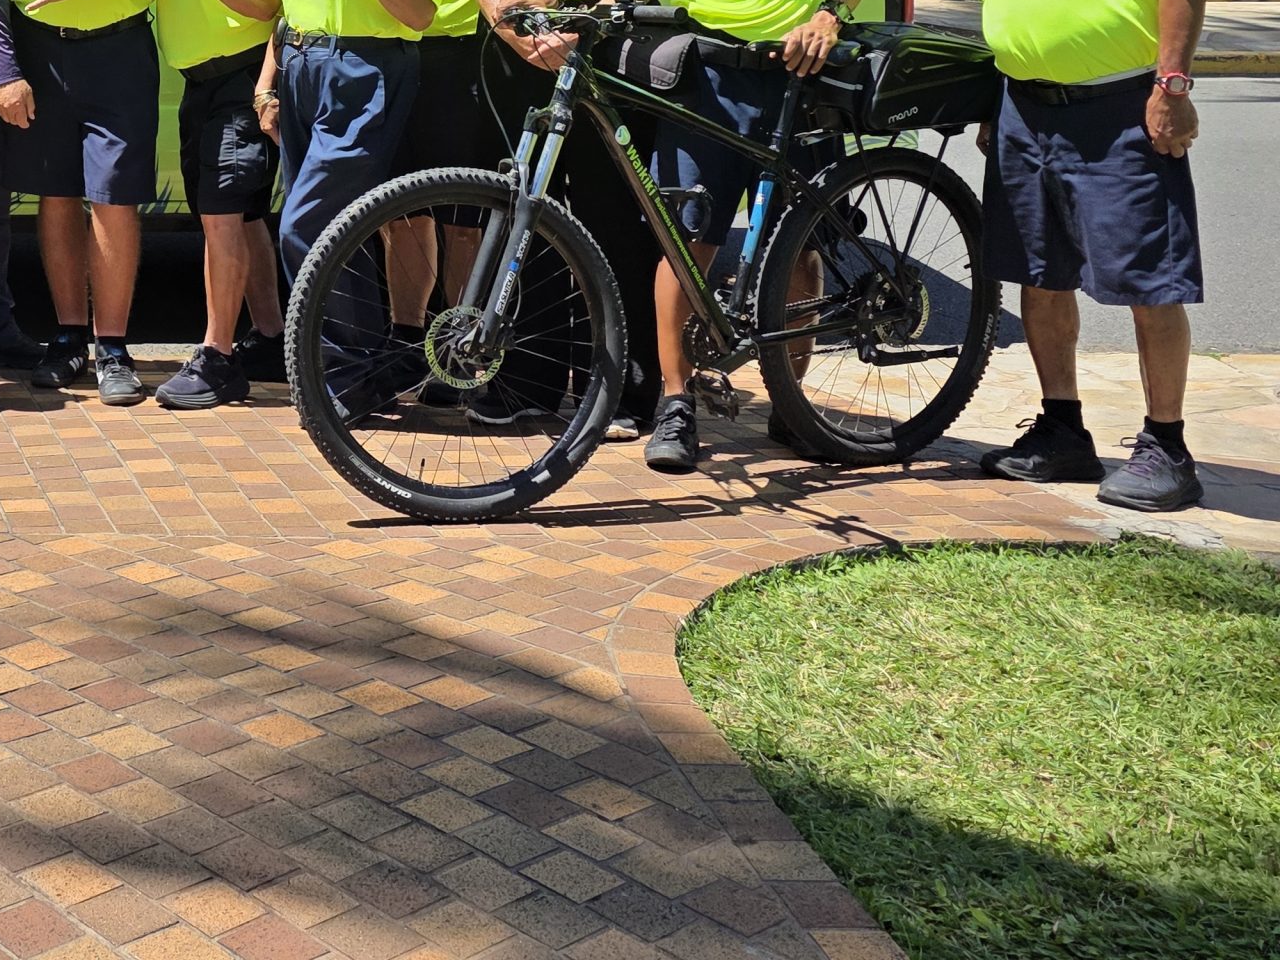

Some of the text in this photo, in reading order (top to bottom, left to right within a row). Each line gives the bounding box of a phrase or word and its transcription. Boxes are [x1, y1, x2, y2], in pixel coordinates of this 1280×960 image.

[654, 196, 672, 227] Business
[670, 224, 694, 268] Improvement
[690, 265, 707, 291] District
[982, 313, 994, 351] GIANT
[373, 476, 412, 499] GIANT
